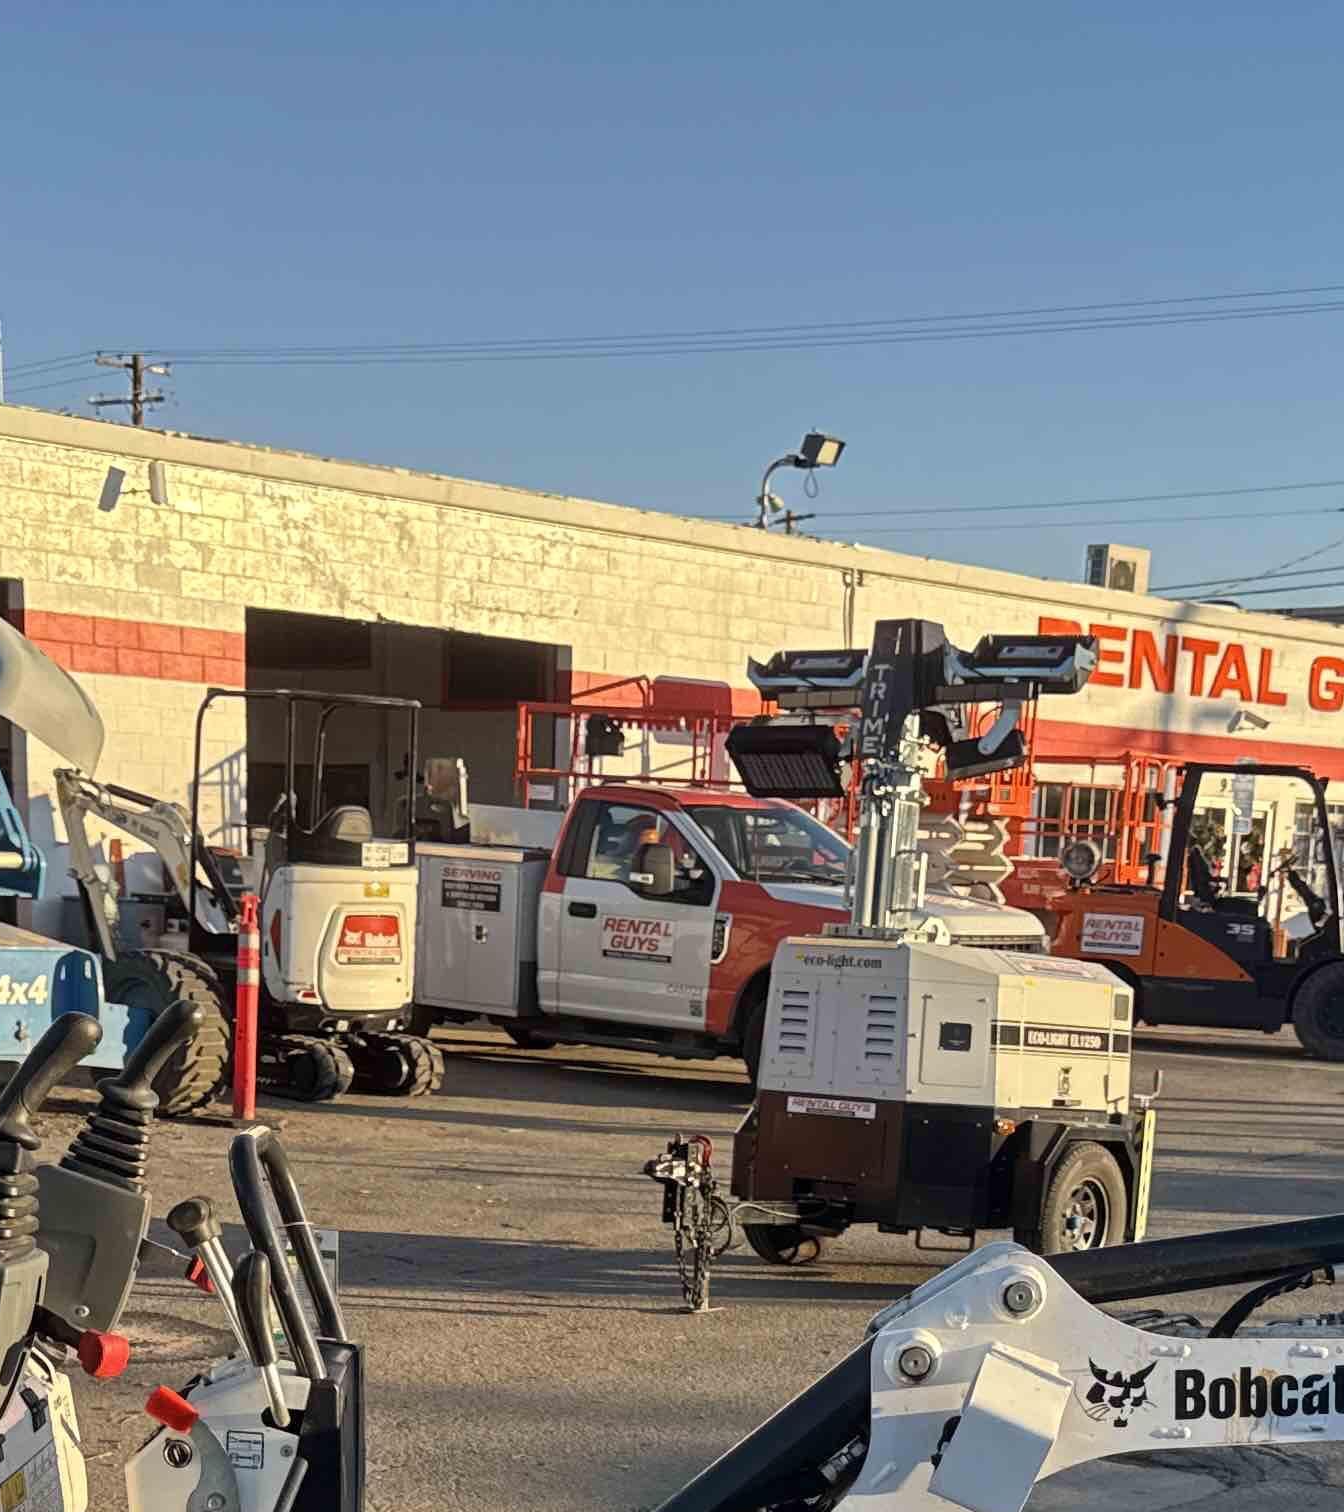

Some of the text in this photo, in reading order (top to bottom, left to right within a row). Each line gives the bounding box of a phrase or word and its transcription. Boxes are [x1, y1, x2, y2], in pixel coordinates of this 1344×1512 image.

[862, 664, 891, 754] TRIME
[442, 867, 502, 881] SERVING
[603, 918, 672, 937] RENTAL
[1085, 919, 1141, 932] RENTAL
[610, 935, 660, 952] GUYS
[1090, 930, 1133, 942] GUYS
[804, 954, 883, 969] eco-light.com
[791, 1097, 837, 1111] RENTAL
[838, 1102, 872, 1113] GUYS
